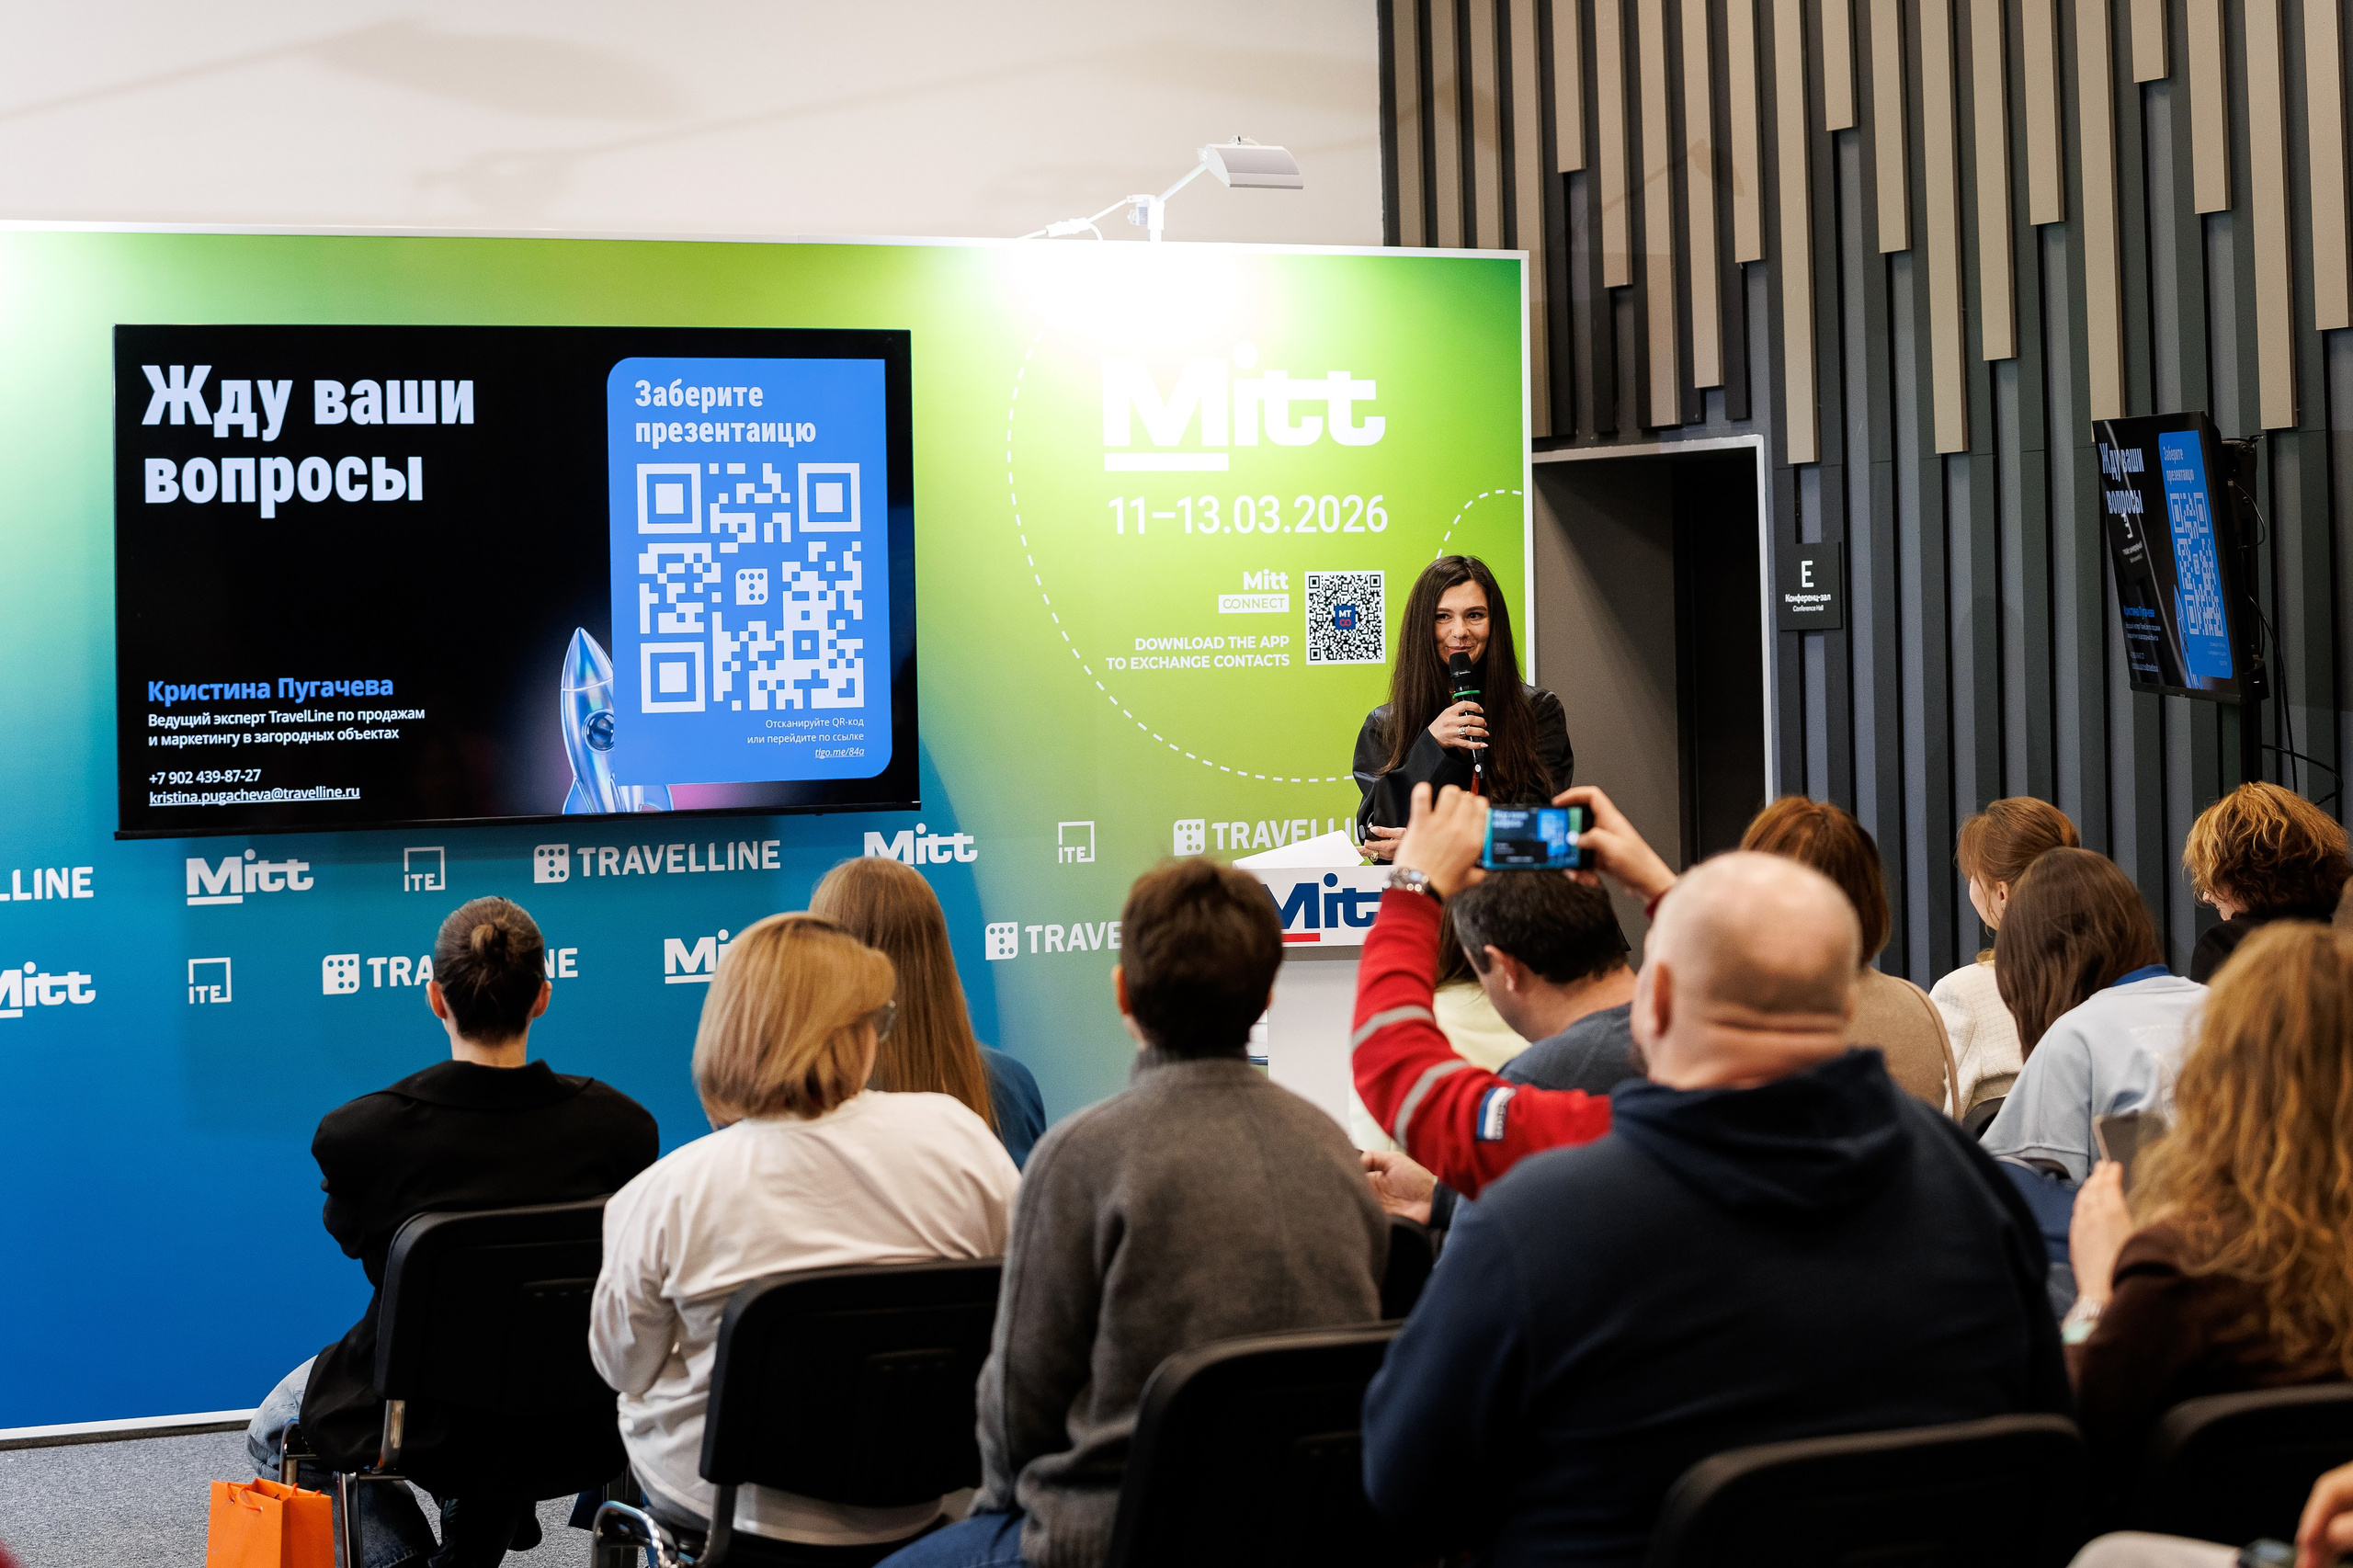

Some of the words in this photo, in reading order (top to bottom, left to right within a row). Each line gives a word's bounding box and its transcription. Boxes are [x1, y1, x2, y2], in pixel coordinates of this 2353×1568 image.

[142, 365, 293, 441] Жду
[314, 379, 474, 425] ваши
[635, 379, 764, 414] Заберите
[1103, 343, 1386, 447] Mitt
[635, 422, 816, 449] презентаицю
[2120, 449, 2144, 472] ваши
[144, 456, 423, 518] вопросы
[2106, 489, 2143, 522] вопросы
[1243, 568, 1290, 591] Mitt
[1802, 560, 1814, 588] E
[1222, 597, 1285, 609] CONNECT
[1785, 594, 1831, 604] Конференц-зал
[1338, 609, 1352, 618] MT
[1134, 637, 1224, 652] DOWNLOAD
[1228, 636, 1256, 649] THE
[1259, 635, 1290, 649] APP
[1106, 657, 1126, 670] TO
[1131, 654, 1211, 670] EXCHANGE
[1214, 653, 1290, 668] CONTACTS
[148, 681, 271, 707] Кристина
[278, 677, 394, 703] Пугачева
[148, 712, 211, 730] Ведущий
[213, 711, 267, 727] эксперт
[268, 709, 335, 723] TravelLine
[337, 710, 355, 722] по
[358, 709, 426, 723] продажам
[765, 718, 830, 730] Отсканируйте
[832, 717, 865, 728] QR-код
[148, 735, 158, 746] и
[161, 732, 240, 749] маркетингу
[243, 732, 252, 744] в
[254, 729, 335, 745] загородных
[336, 727, 400, 741] объектах
[767, 733, 816, 745] перейдите
[832, 733, 864, 742] ссылке
[149, 772, 165, 785] +7
[168, 771, 193, 785] 902
[196, 769, 261, 784] 439-87-27
[149, 786, 360, 806] kristina.pugacheva@travelline.ru
[864, 823, 978, 864] Mitt
[576, 839, 781, 877] TRAVELLINE
[0, 867, 94, 902] LINE
[186, 848, 314, 897] Mitt
[1261, 872, 1386, 929] Mit
[664, 928, 735, 974] Mi
[1025, 921, 1122, 955] TRAVE
